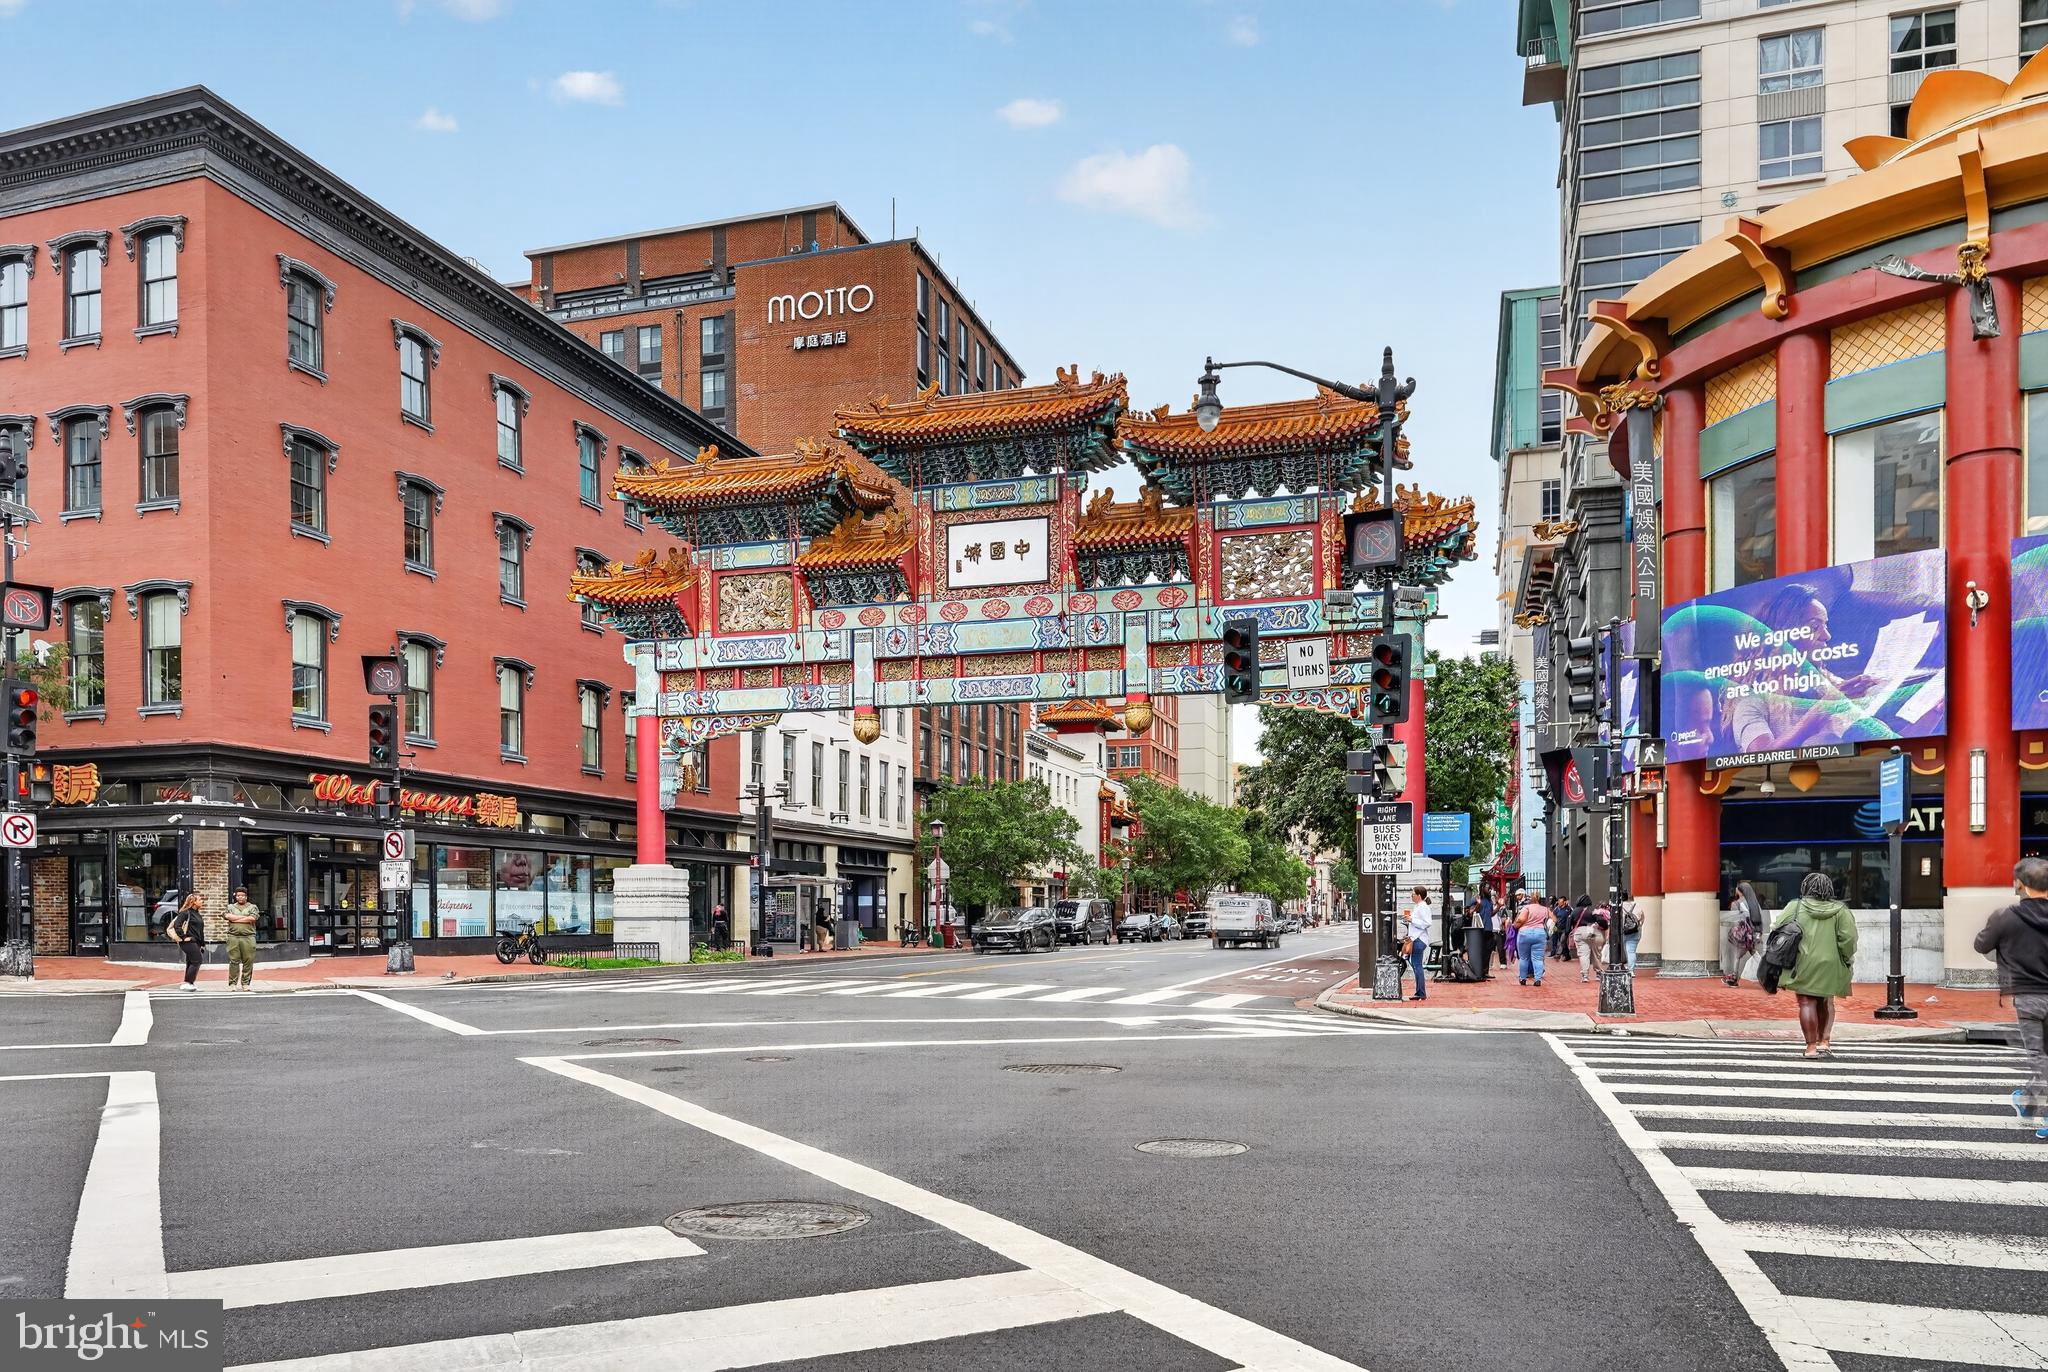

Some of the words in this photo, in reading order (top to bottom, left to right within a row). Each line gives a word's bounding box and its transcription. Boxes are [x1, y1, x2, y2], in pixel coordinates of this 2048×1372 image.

[793, 331, 847, 350] 摩庭酒店
[1633, 460, 1656, 600] 美國娛樂公司
[1735, 632, 1760, 650] We
[1764, 625, 1815, 647] agree,
[1300, 645, 1314, 658] NO
[1292, 663, 1324, 677] TURNS
[1704, 659, 1750, 680] energy
[1754, 648, 1807, 673] supply
[1812, 642, 1859, 661] costs
[1726, 684, 1749, 699] are
[1752, 681, 1778, 695] too
[1716, 753, 1755, 767] ORANGE
[1758, 750, 1797, 764] BARREL
[1802, 746, 1840, 759] MEDIA
[308, 773, 475, 817] Walreens
[1377, 806, 1397, 814] RIGHT
[1904, 807, 1944, 832] AT
[1373, 825, 1401, 834] BUSES
[1374, 834, 1400, 842] BIKES
[1375, 842, 1399, 850] ONLY
[1371, 863, 1404, 871] MON-FRI
